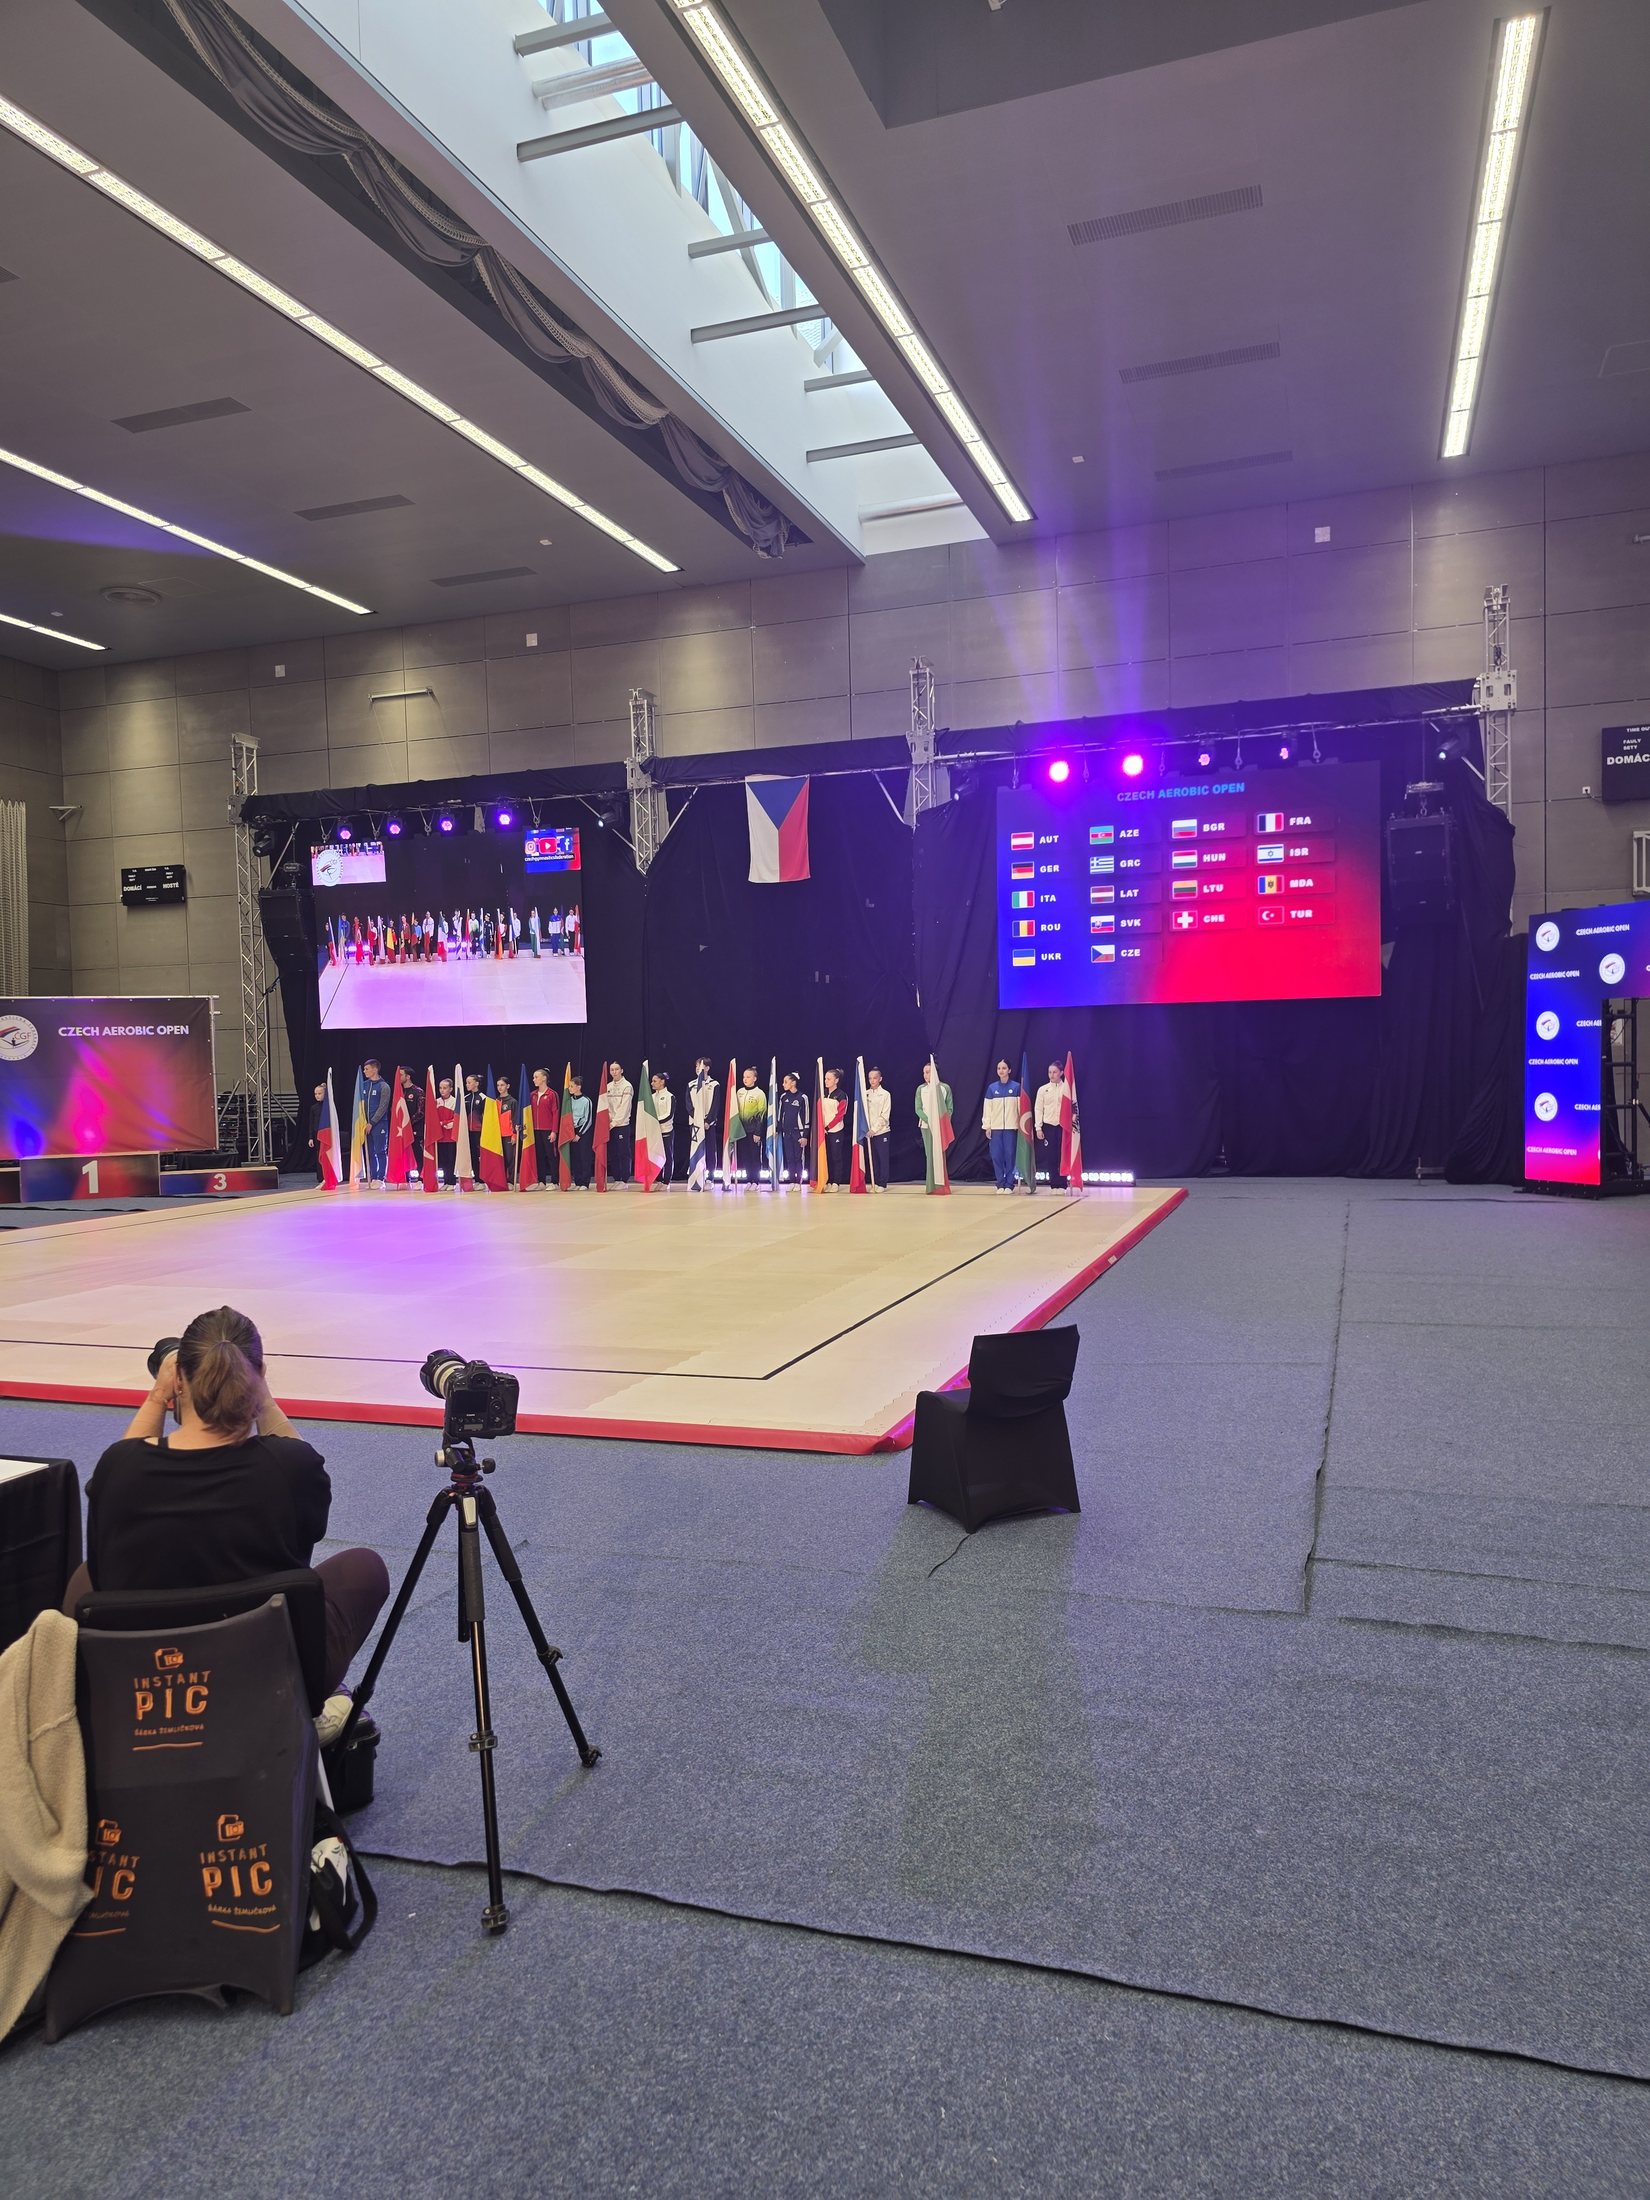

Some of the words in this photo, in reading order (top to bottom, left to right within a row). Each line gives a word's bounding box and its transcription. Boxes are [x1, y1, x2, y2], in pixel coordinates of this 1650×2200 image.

[1116, 790, 1155, 801] CZECH
[1158, 785, 1209, 798] AEROBIC
[1212, 782, 1245, 794] OPEN
[1289, 816, 1312, 826] FRA
[1203, 823, 1225, 832] BGR
[1119, 829, 1140, 838] AZE
[1039, 835, 1059, 844] AUT
[1289, 848, 1309, 857] ISR
[1203, 853, 1226, 862] HUN
[1120, 859, 1141, 868] GRC
[1040, 865, 1060, 873] GER
[1289, 878, 1314, 888] MDA
[1203, 884, 1224, 893] LTU
[1120, 889, 1139, 898] LAT
[1040, 894, 1056, 903] ITA
[1203, 914, 1225, 923] CHE
[1290, 910, 1313, 919] TUR
[1041, 923, 1061, 932] ROU
[1120, 919, 1141, 927] SVK
[1576, 928, 1593, 936] CZECH
[1615, 924, 1630, 932] OPEN
[1120, 949, 1140, 957] CZE
[58, 1026, 99, 1036] CZECH
[102, 1025, 155, 1036] AEROBIC
[156, 1025, 190, 1035] OPEN
[82, 1160, 99, 1194] 1
[213, 1173, 227, 1191] 3
[133, 1670, 211, 1689] INSTANT
[135, 1685, 209, 1720] PIC
[200, 1843, 267, 1865] INSTANT
[88, 1850, 140, 1868] STANT
[94, 1865, 135, 1900] IC
[202, 1861, 273, 1897] PIC
